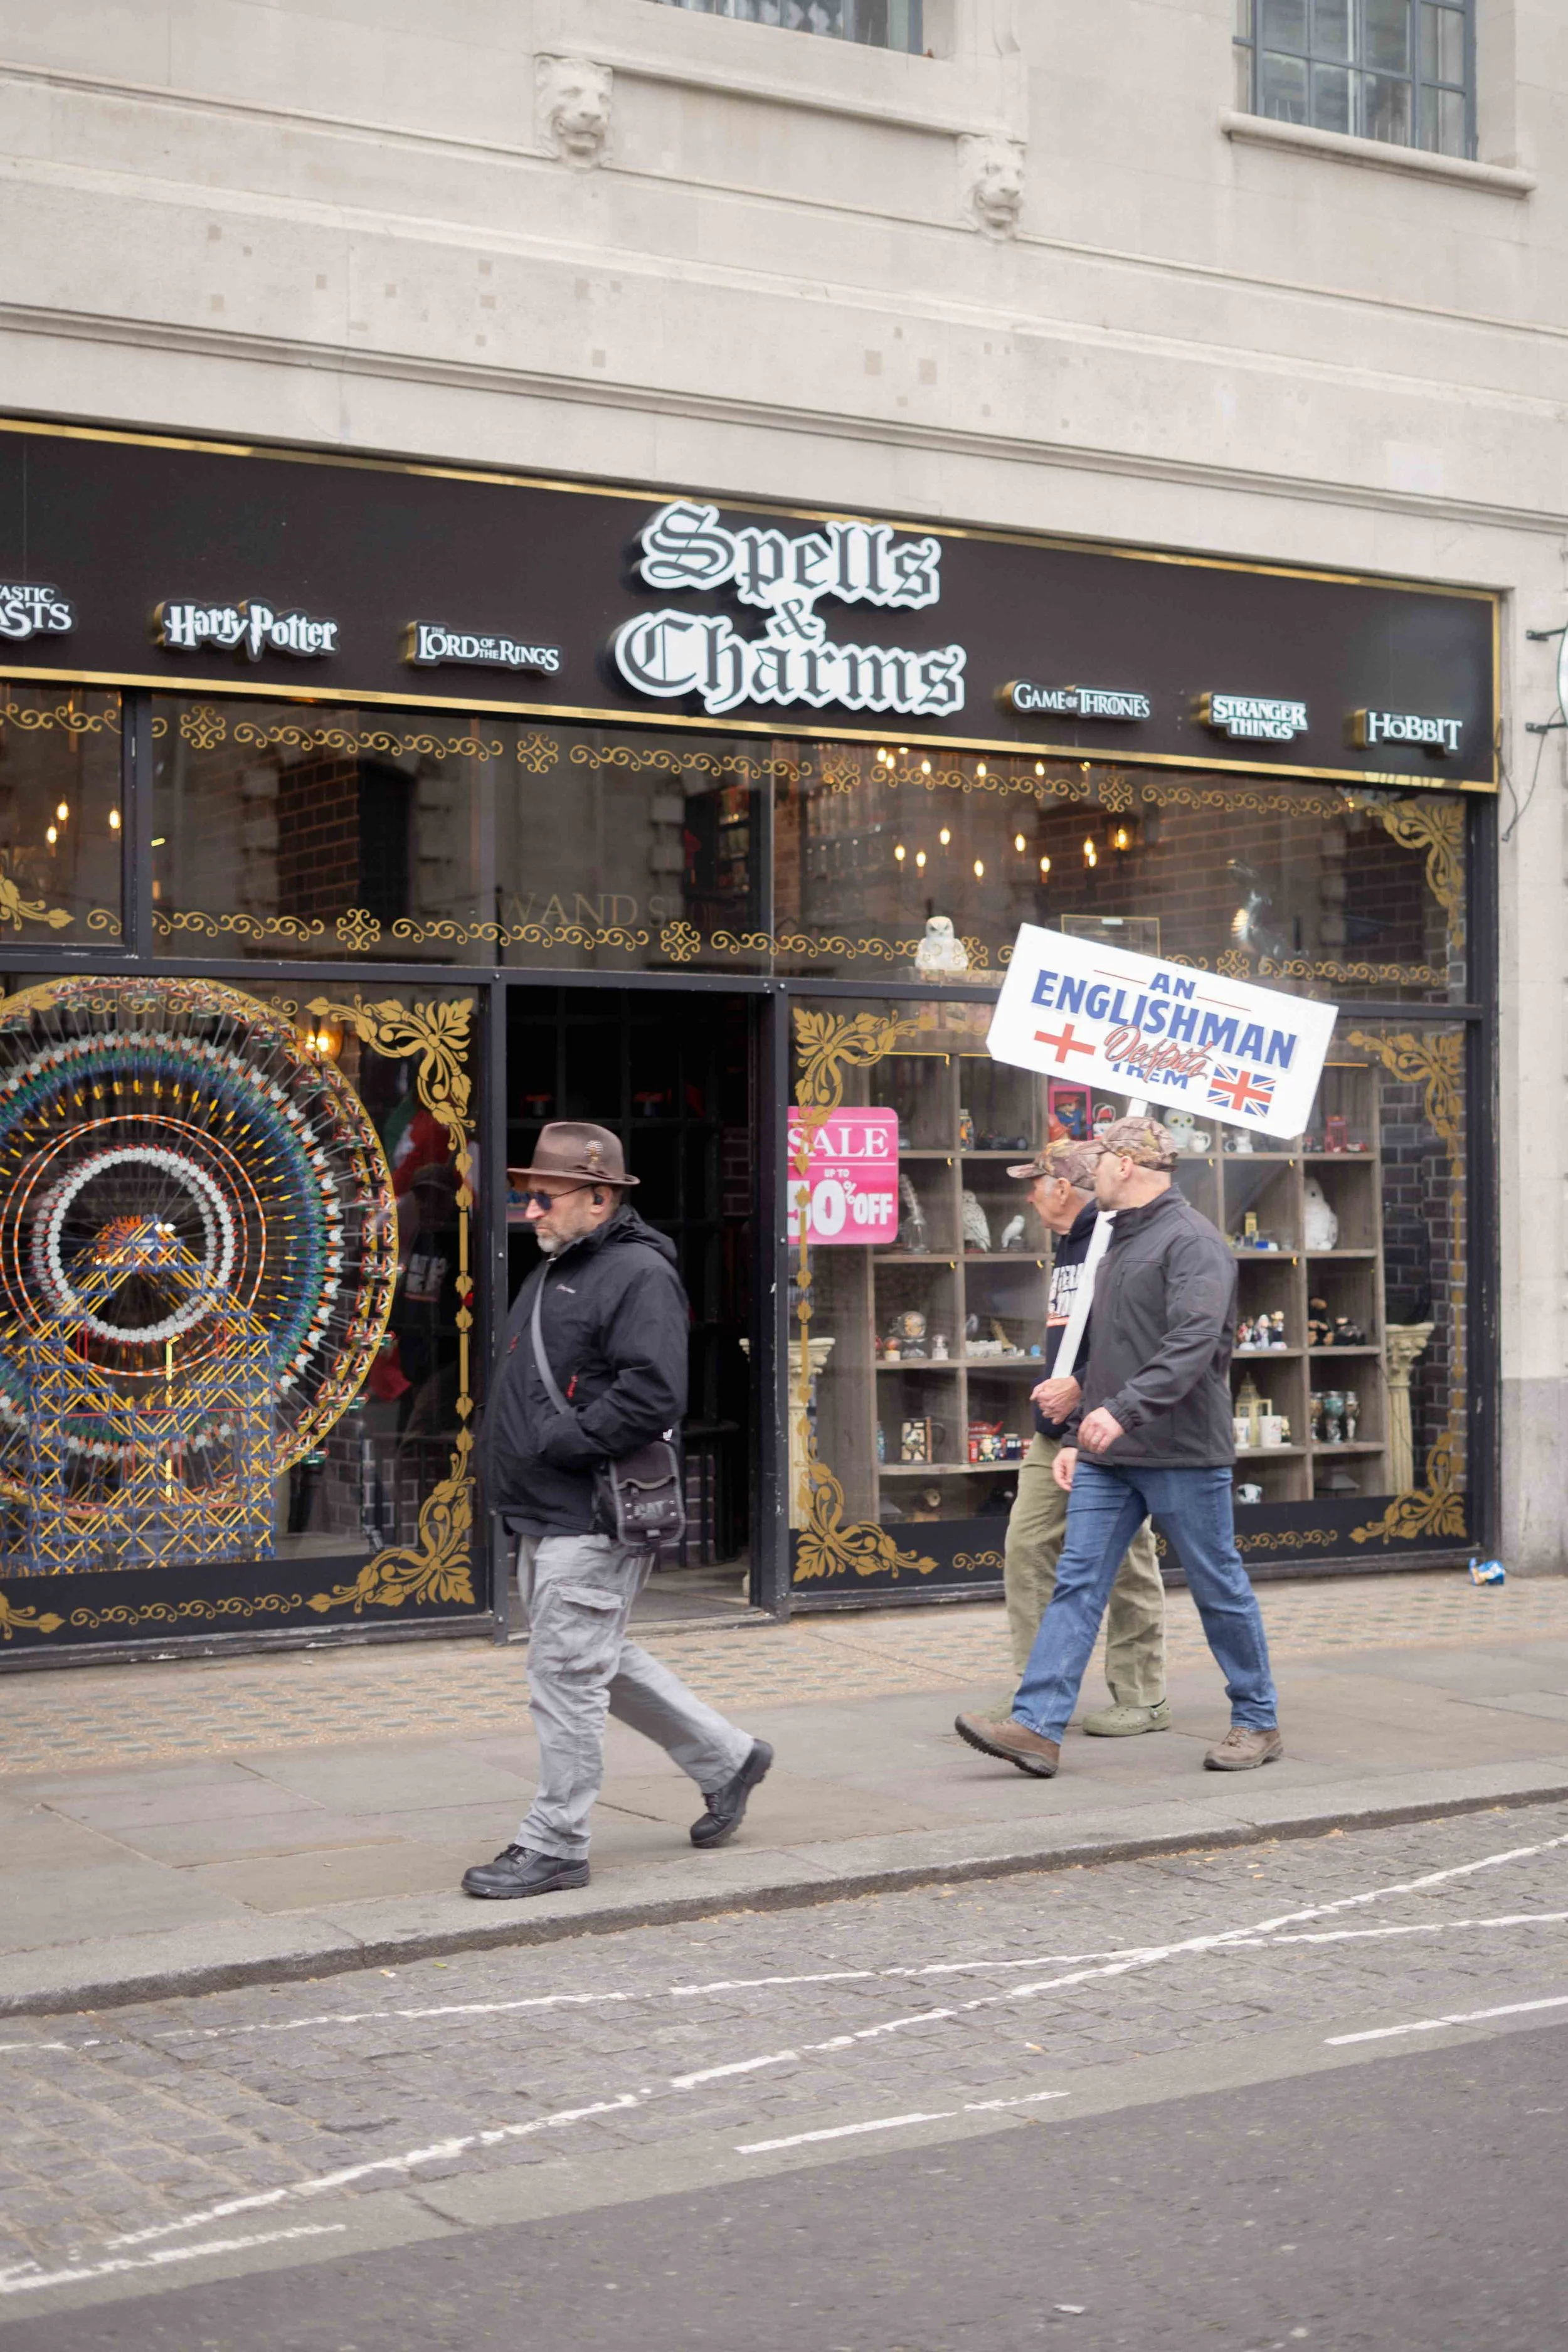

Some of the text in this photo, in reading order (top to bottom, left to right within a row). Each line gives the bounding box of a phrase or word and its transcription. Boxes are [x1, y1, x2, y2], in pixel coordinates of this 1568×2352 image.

[646, 504, 937, 602] Spells
[0, 585, 55, 603] ASTIC
[164, 605, 338, 655] Harry Potter
[773, 597, 818, 640] &
[418, 625, 560, 671] LORD OF THE RINGS
[623, 616, 962, 707] Charms
[1013, 683, 1151, 718] GAME OF THRONES
[1212, 695, 1308, 730] STRANGER
[1228, 717, 1295, 739] THINGS
[495, 891, 638, 927] WAND
[1148, 972, 1198, 1000] AN
[1030, 968, 1299, 1069] ENGLISHMAN
[1104, 1024, 1214, 1084] Despite
[1110, 1055, 1189, 1090] THEM
[788, 1127, 889, 1158] SALE
[824, 1168, 850, 1178] UP TO
[854, 1193, 893, 1225] OFF
